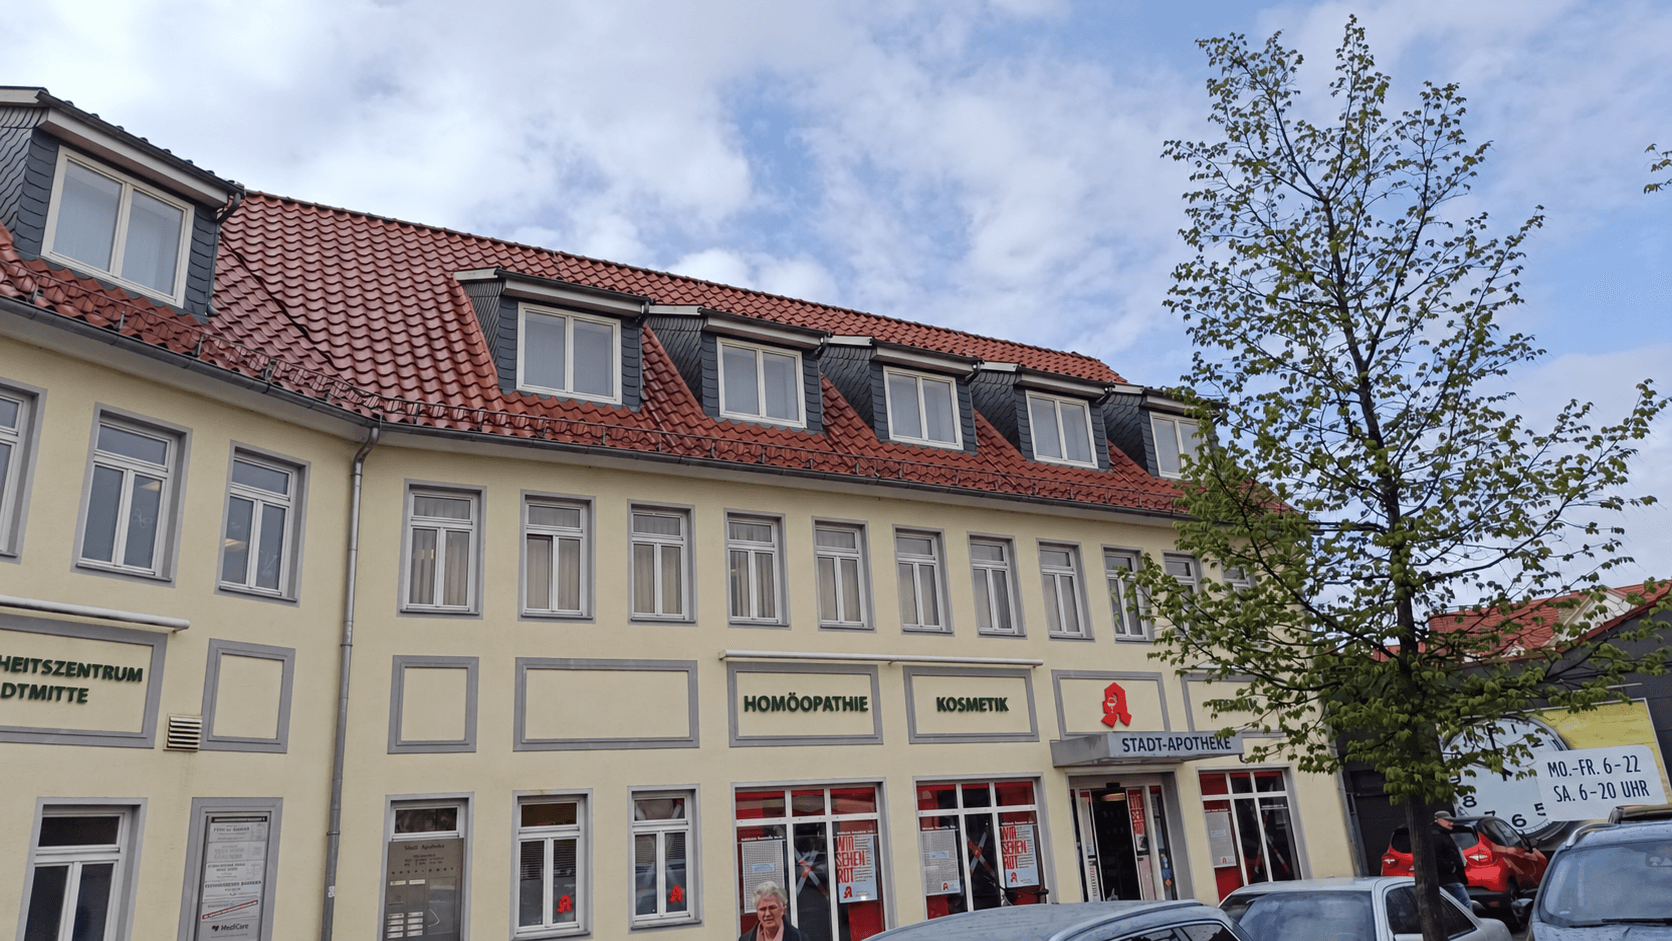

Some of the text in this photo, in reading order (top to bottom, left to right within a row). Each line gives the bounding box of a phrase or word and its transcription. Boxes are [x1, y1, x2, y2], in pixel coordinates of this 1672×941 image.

[0, 655, 143, 682] HEITSZENTRUM
[0, 682, 89, 704] DTMITTE
[743, 691, 869, 713] HOMÖOPATHIE
[936, 696, 1009, 712] KOSMETIK
[1122, 736, 1232, 752] STADT-APOTHEKE
[1553, 784, 1576, 802] SA.
[1620, 779, 1650, 798] UHR
[1462, 795, 1477, 808] 8
[1511, 813, 1527, 828] 6
